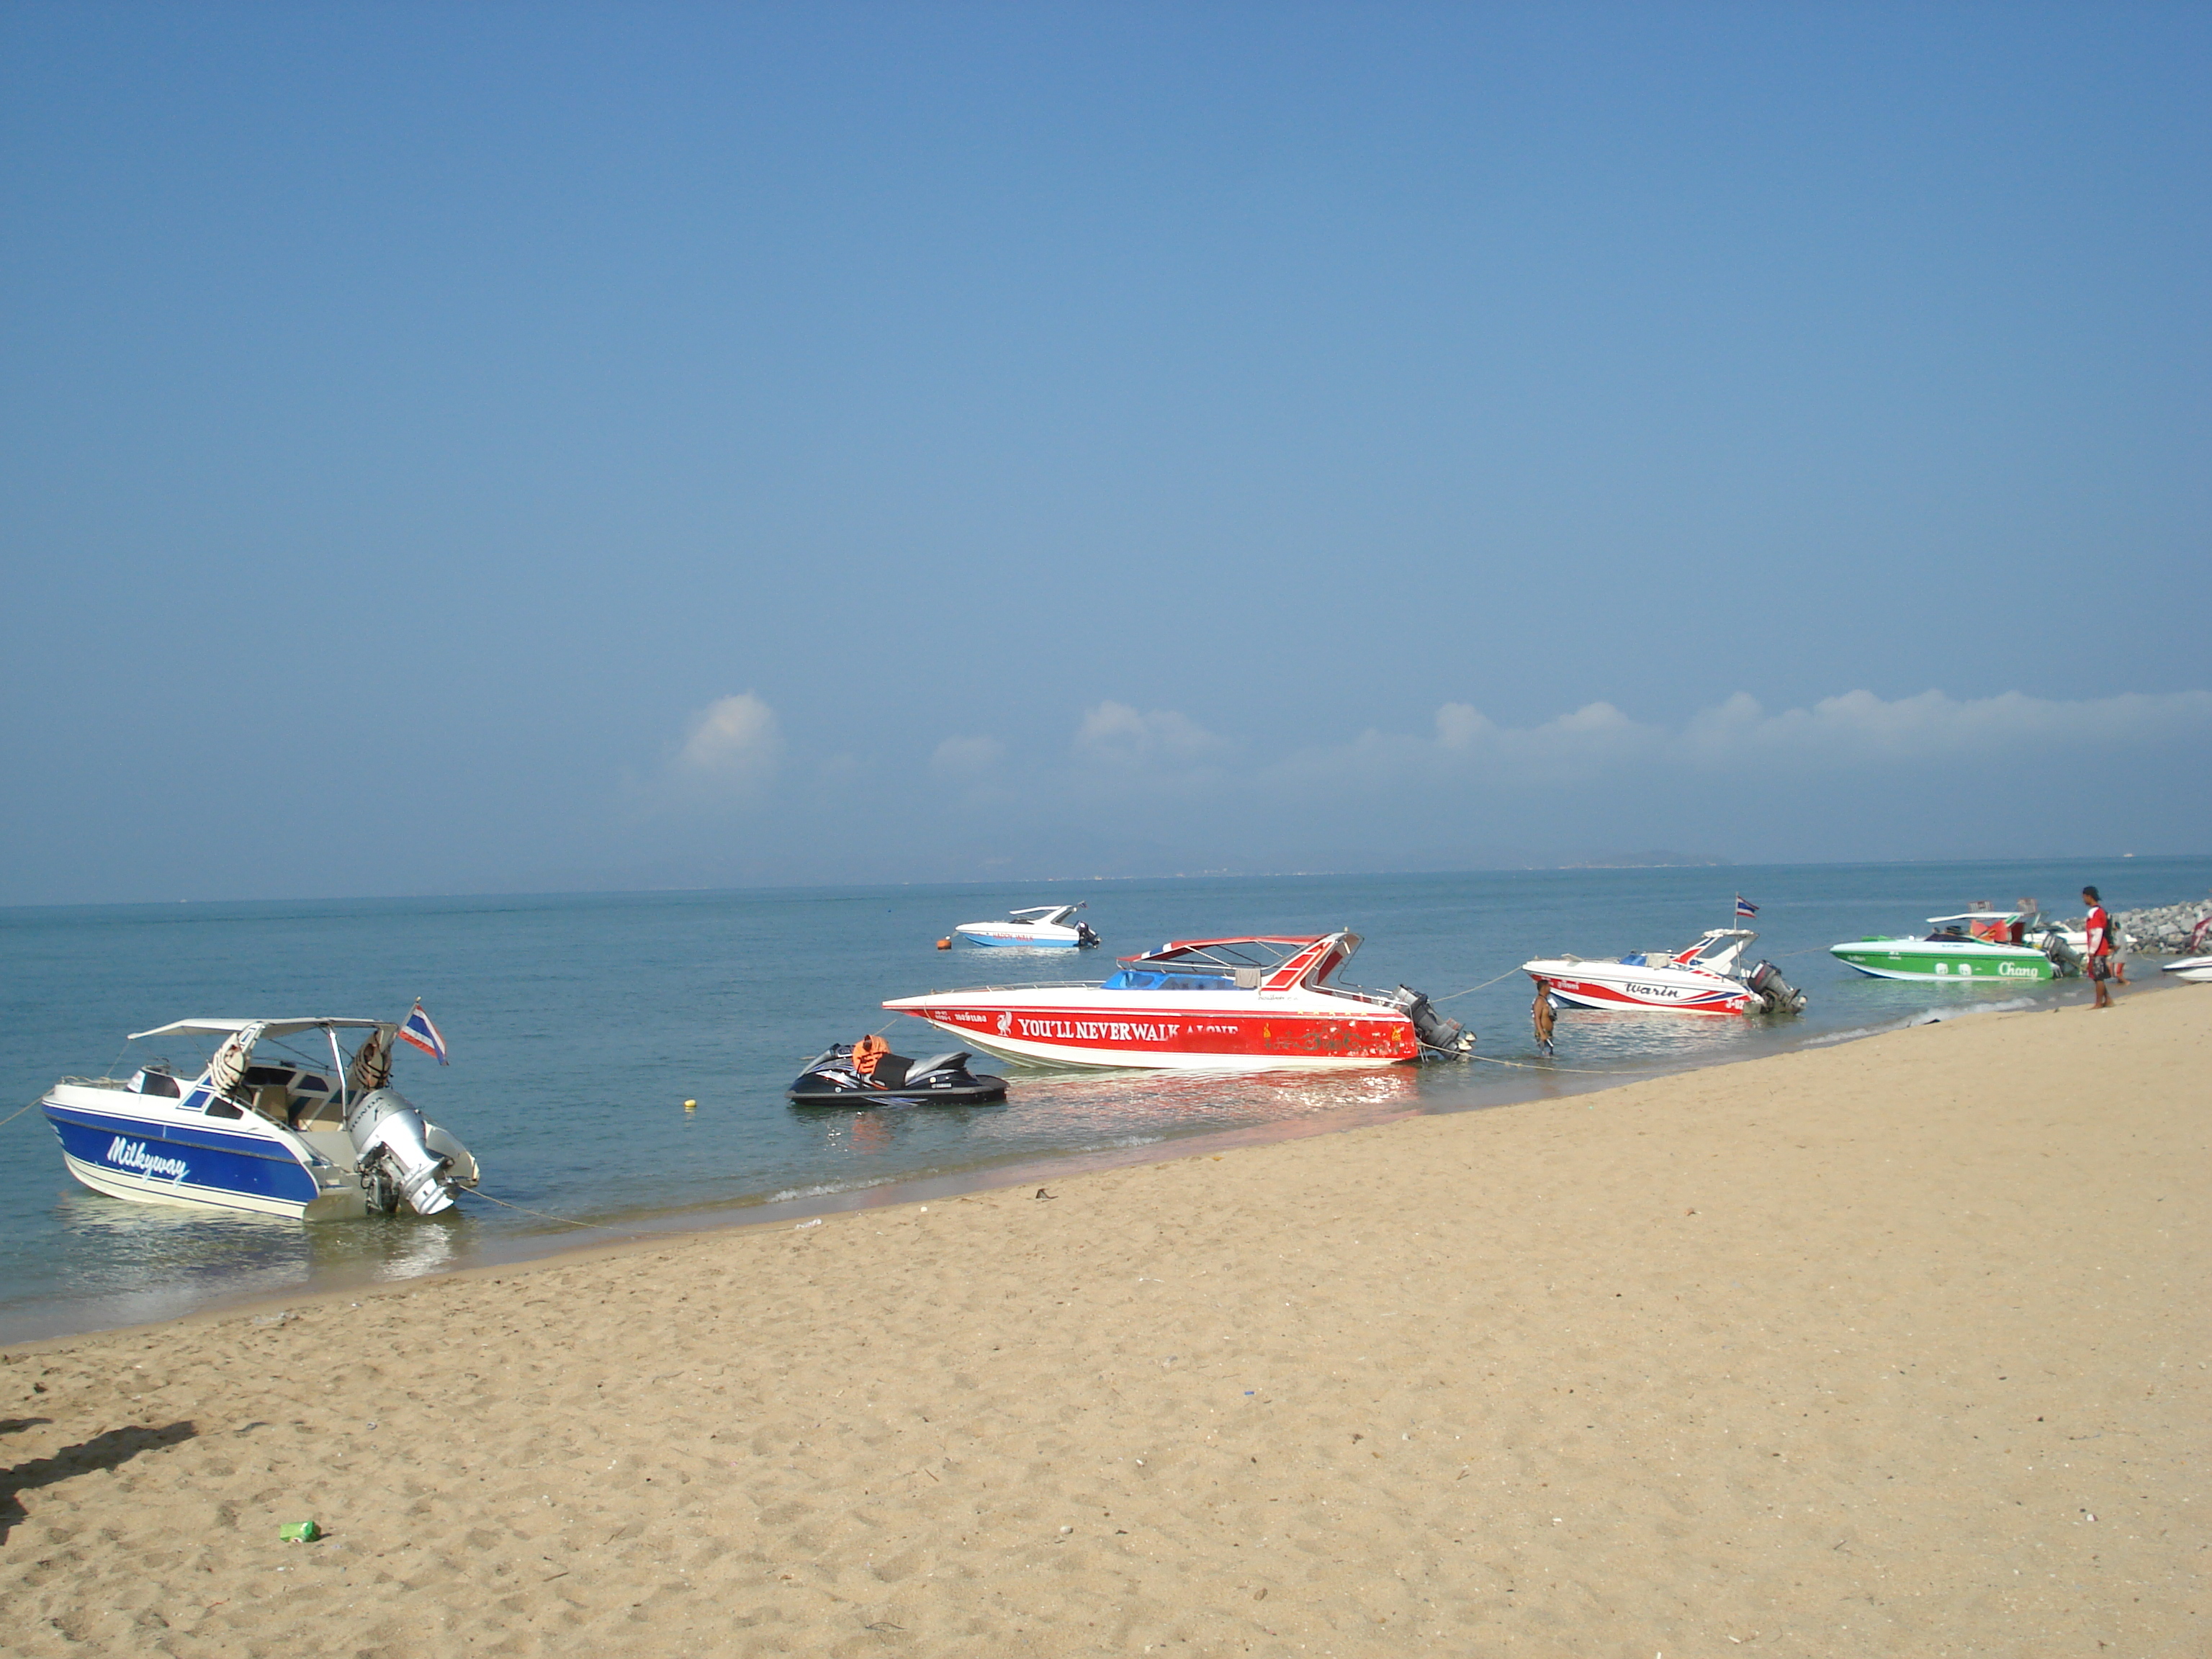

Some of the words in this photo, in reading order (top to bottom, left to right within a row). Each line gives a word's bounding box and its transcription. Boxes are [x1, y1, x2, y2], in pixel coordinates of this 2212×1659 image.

[1998, 961, 2038, 979] Chang
[1075, 1021, 1132, 1040] NEVER
[1129, 1022, 1180, 1042] WALK
